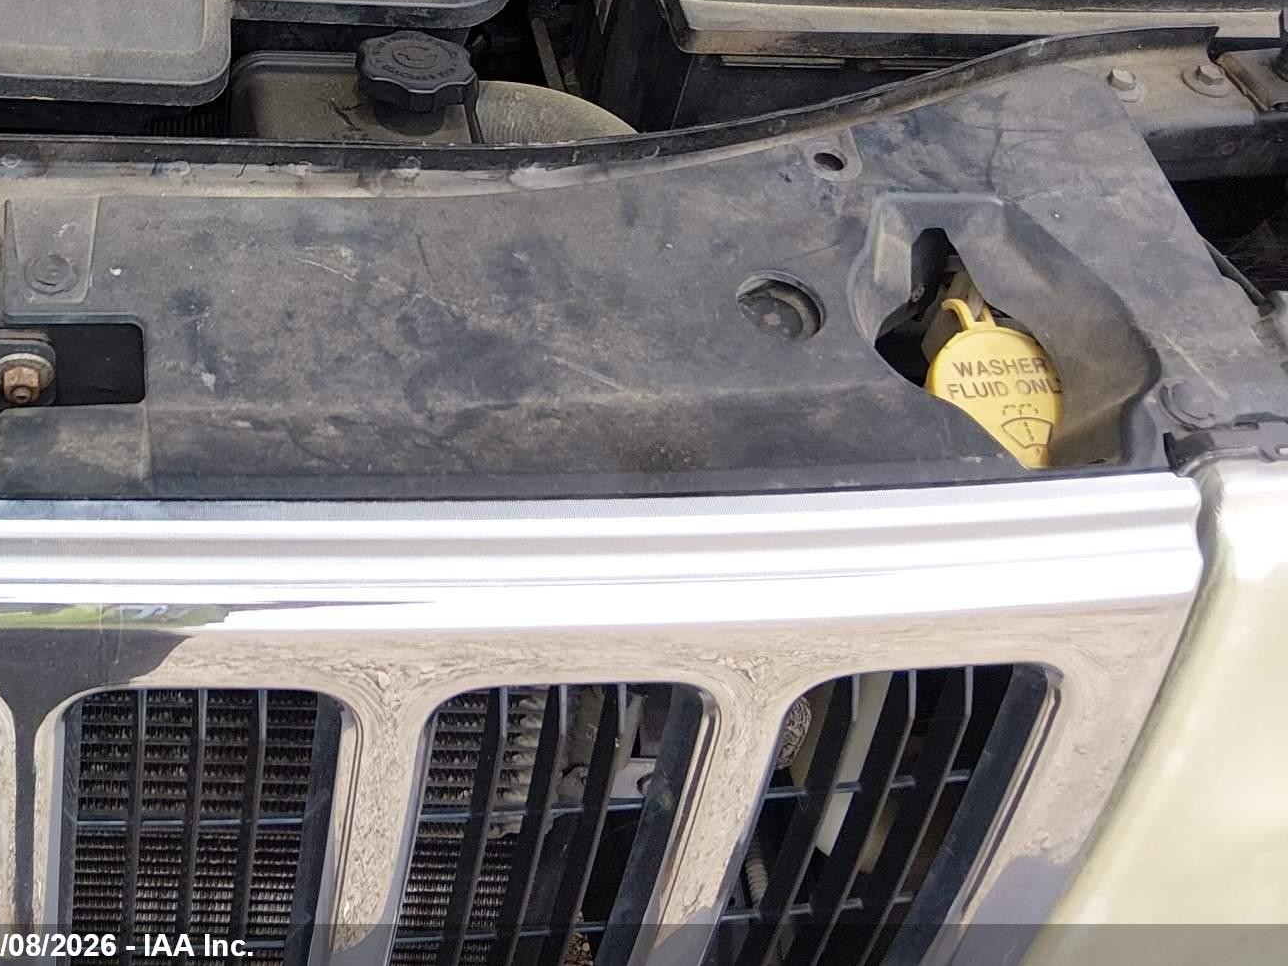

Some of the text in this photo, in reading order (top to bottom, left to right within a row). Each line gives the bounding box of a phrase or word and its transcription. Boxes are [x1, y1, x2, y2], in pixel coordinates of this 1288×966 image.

[952, 357, 1049, 378] WASHER
[946, 378, 1062, 400] FLUID ONL
